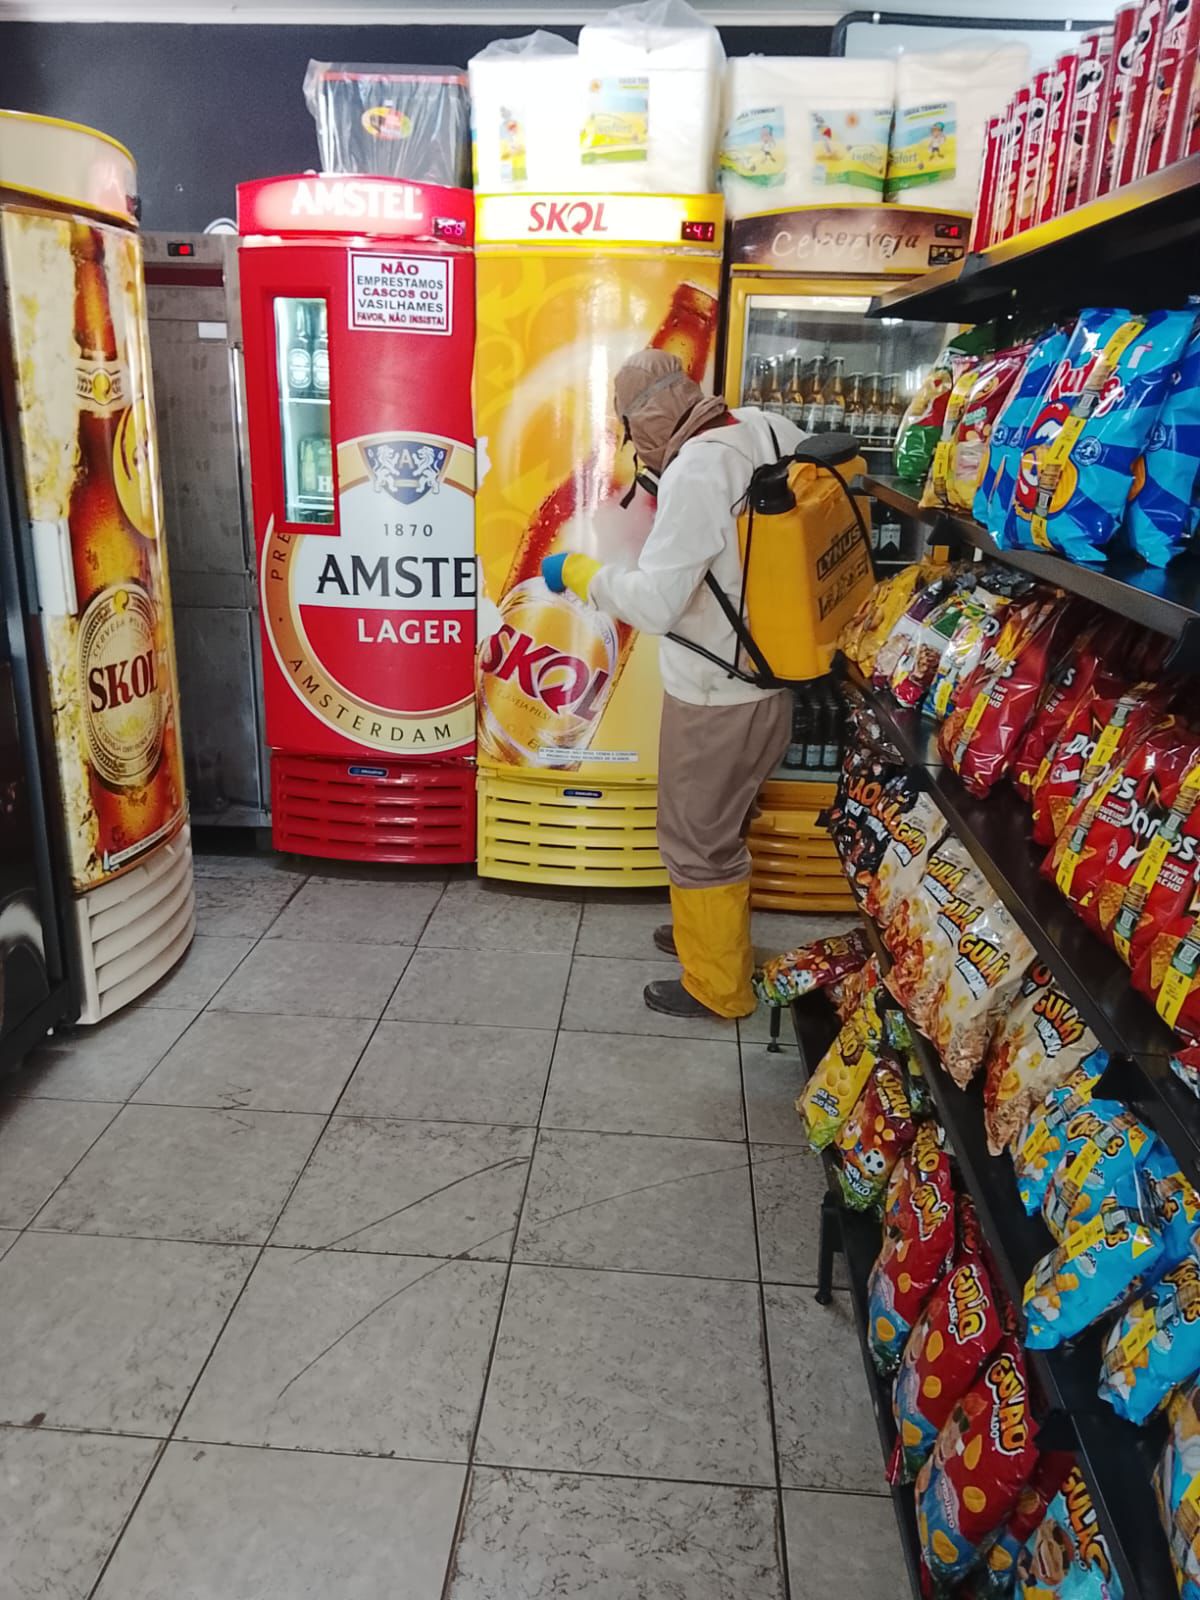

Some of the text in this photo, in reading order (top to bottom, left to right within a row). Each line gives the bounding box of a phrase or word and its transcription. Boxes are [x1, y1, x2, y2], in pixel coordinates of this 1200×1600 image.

[290, 181, 423, 220] AMSTEL
[528, 201, 608, 235] SKOL
[381, 262, 419, 275] NÃO
[357, 275, 443, 290] EMPRESTAMOS
[363, 287, 439, 300] CASCOS OU
[358, 298, 443, 313] VASILHAMES
[384, 523, 433, 537] 1870
[358, 618, 461, 644] LAGER
[480, 624, 609, 721] SKOL
[290, 658, 452, 743] AMSTERDAM
